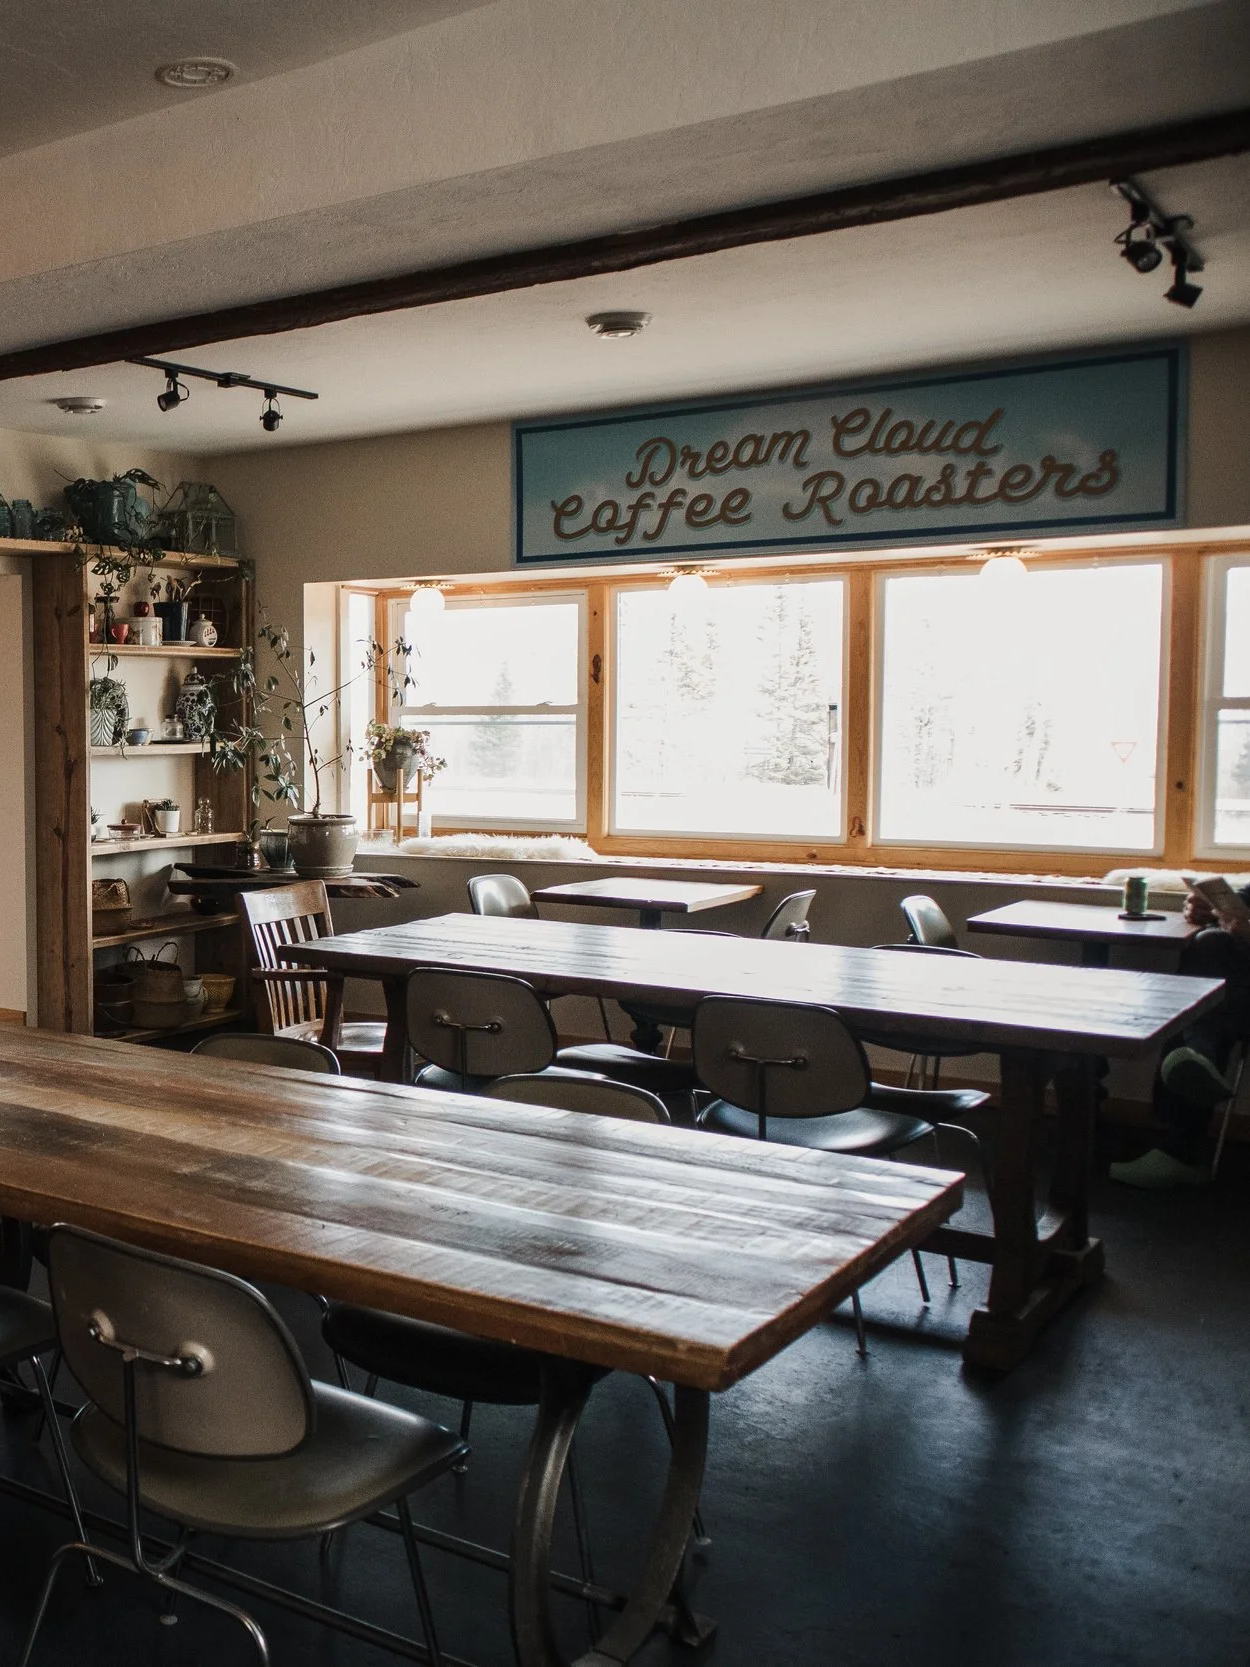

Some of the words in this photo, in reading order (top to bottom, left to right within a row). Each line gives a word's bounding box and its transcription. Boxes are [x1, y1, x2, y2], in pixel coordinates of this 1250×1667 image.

[625, 428, 812, 490] Dream
[831, 406, 1006, 458] Cloud
[550, 486, 754, 546] Coffee
[781, 448, 1120, 527] Roasters
